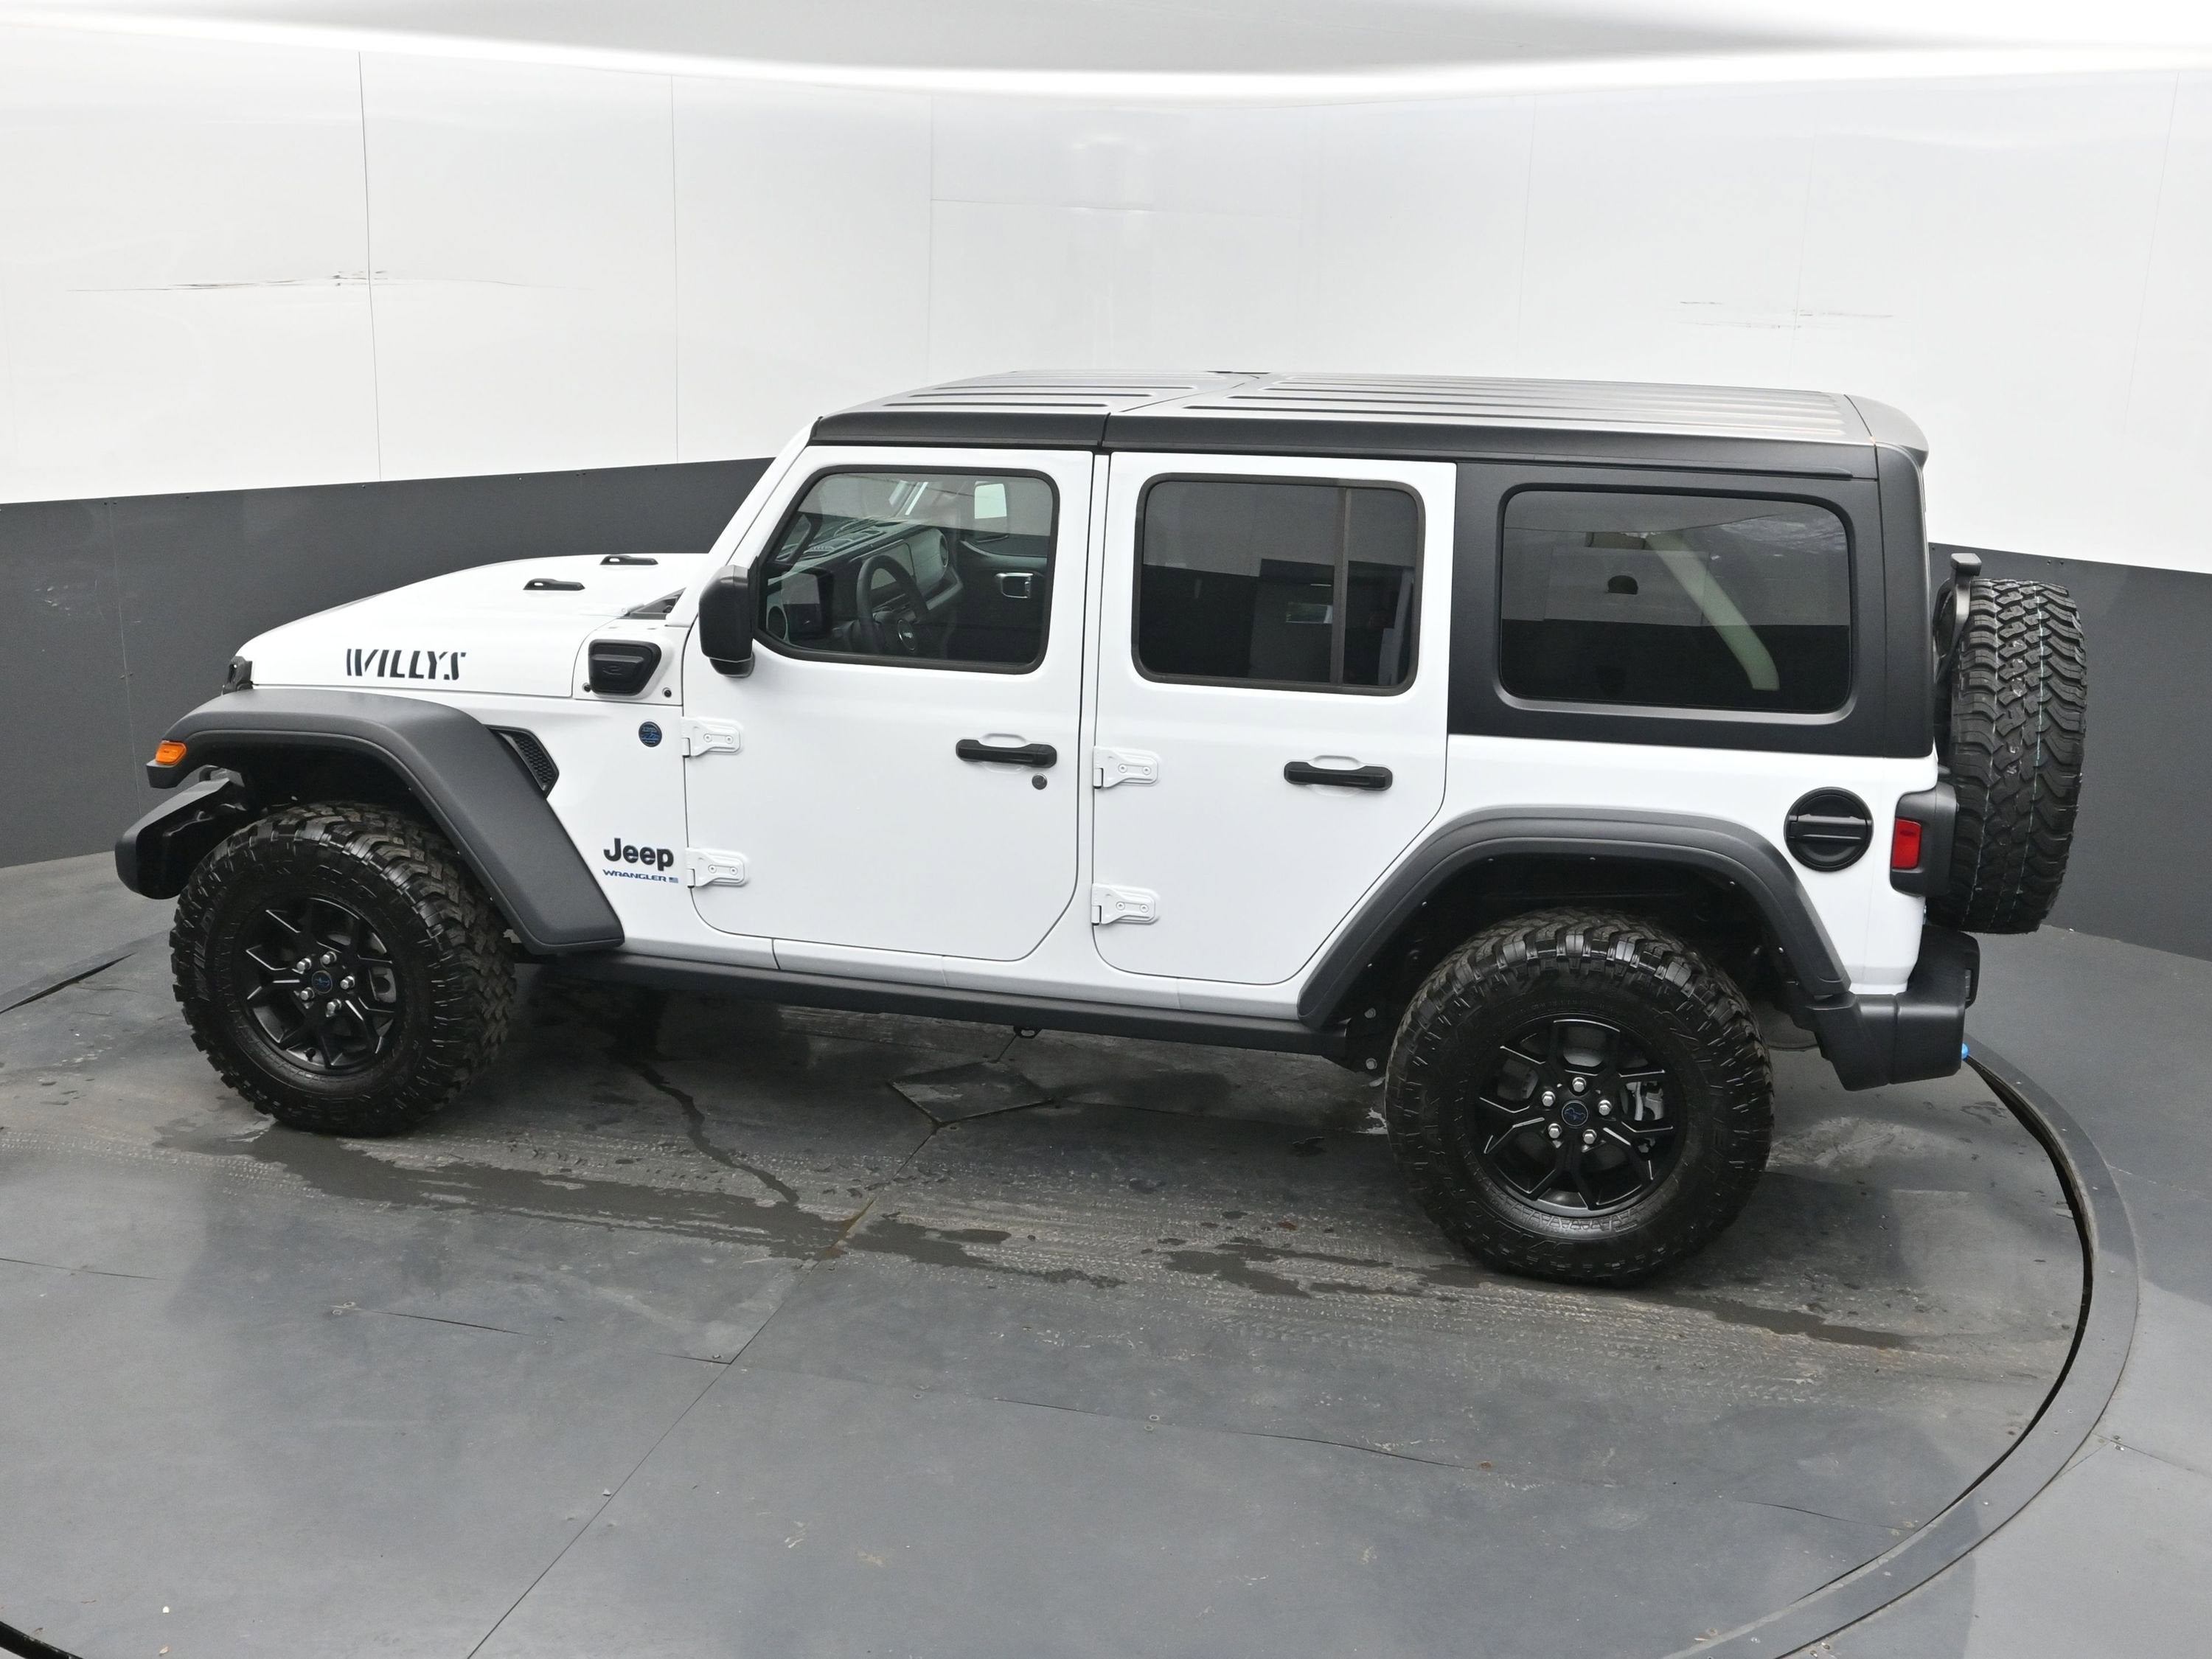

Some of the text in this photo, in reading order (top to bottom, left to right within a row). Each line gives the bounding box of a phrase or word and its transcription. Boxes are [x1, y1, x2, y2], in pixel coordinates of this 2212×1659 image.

[346, 648, 467, 681] WILLYS
[603, 837, 675, 872] Jeep
[602, 869, 667, 883] WRANGLER
